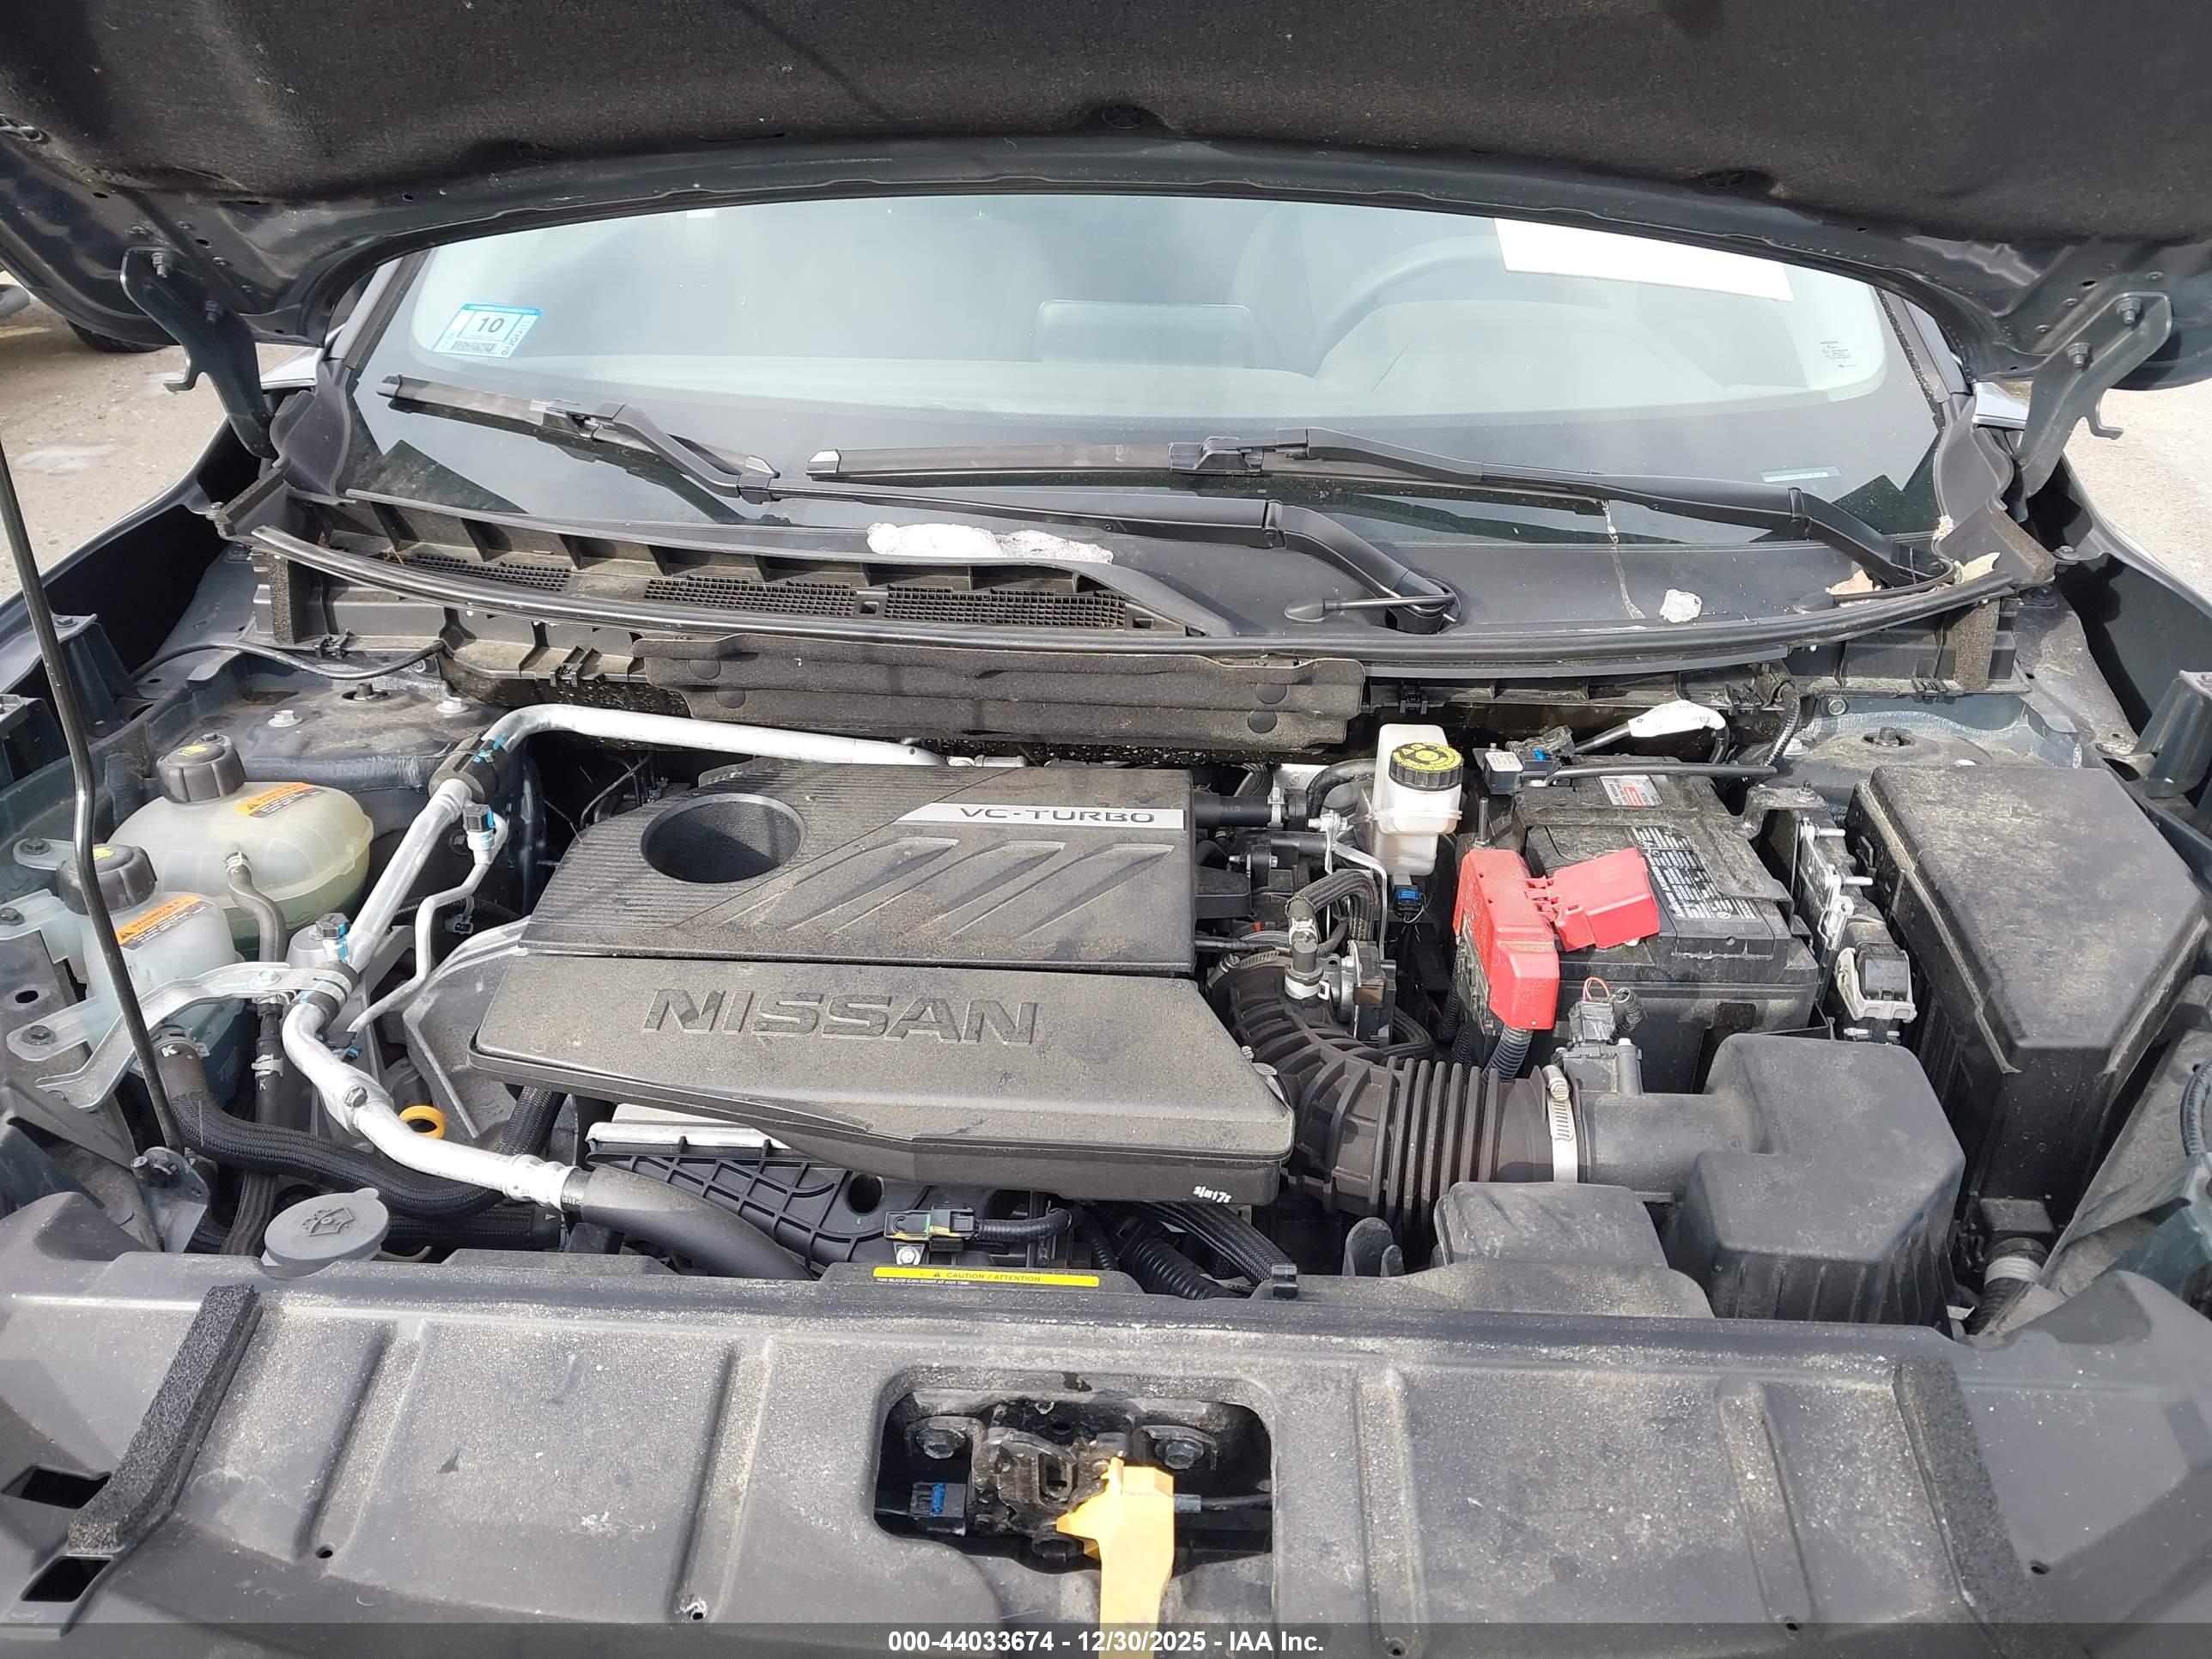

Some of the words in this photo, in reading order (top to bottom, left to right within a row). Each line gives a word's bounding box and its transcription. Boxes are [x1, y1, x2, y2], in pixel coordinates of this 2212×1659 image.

[477, 316, 505, 334] 10
[958, 807, 1156, 823] VC-TURBO
[641, 988, 1040, 1047] NISSAN
[161, 1044, 178, 1057] K
[258, 1078, 267, 1091] K
